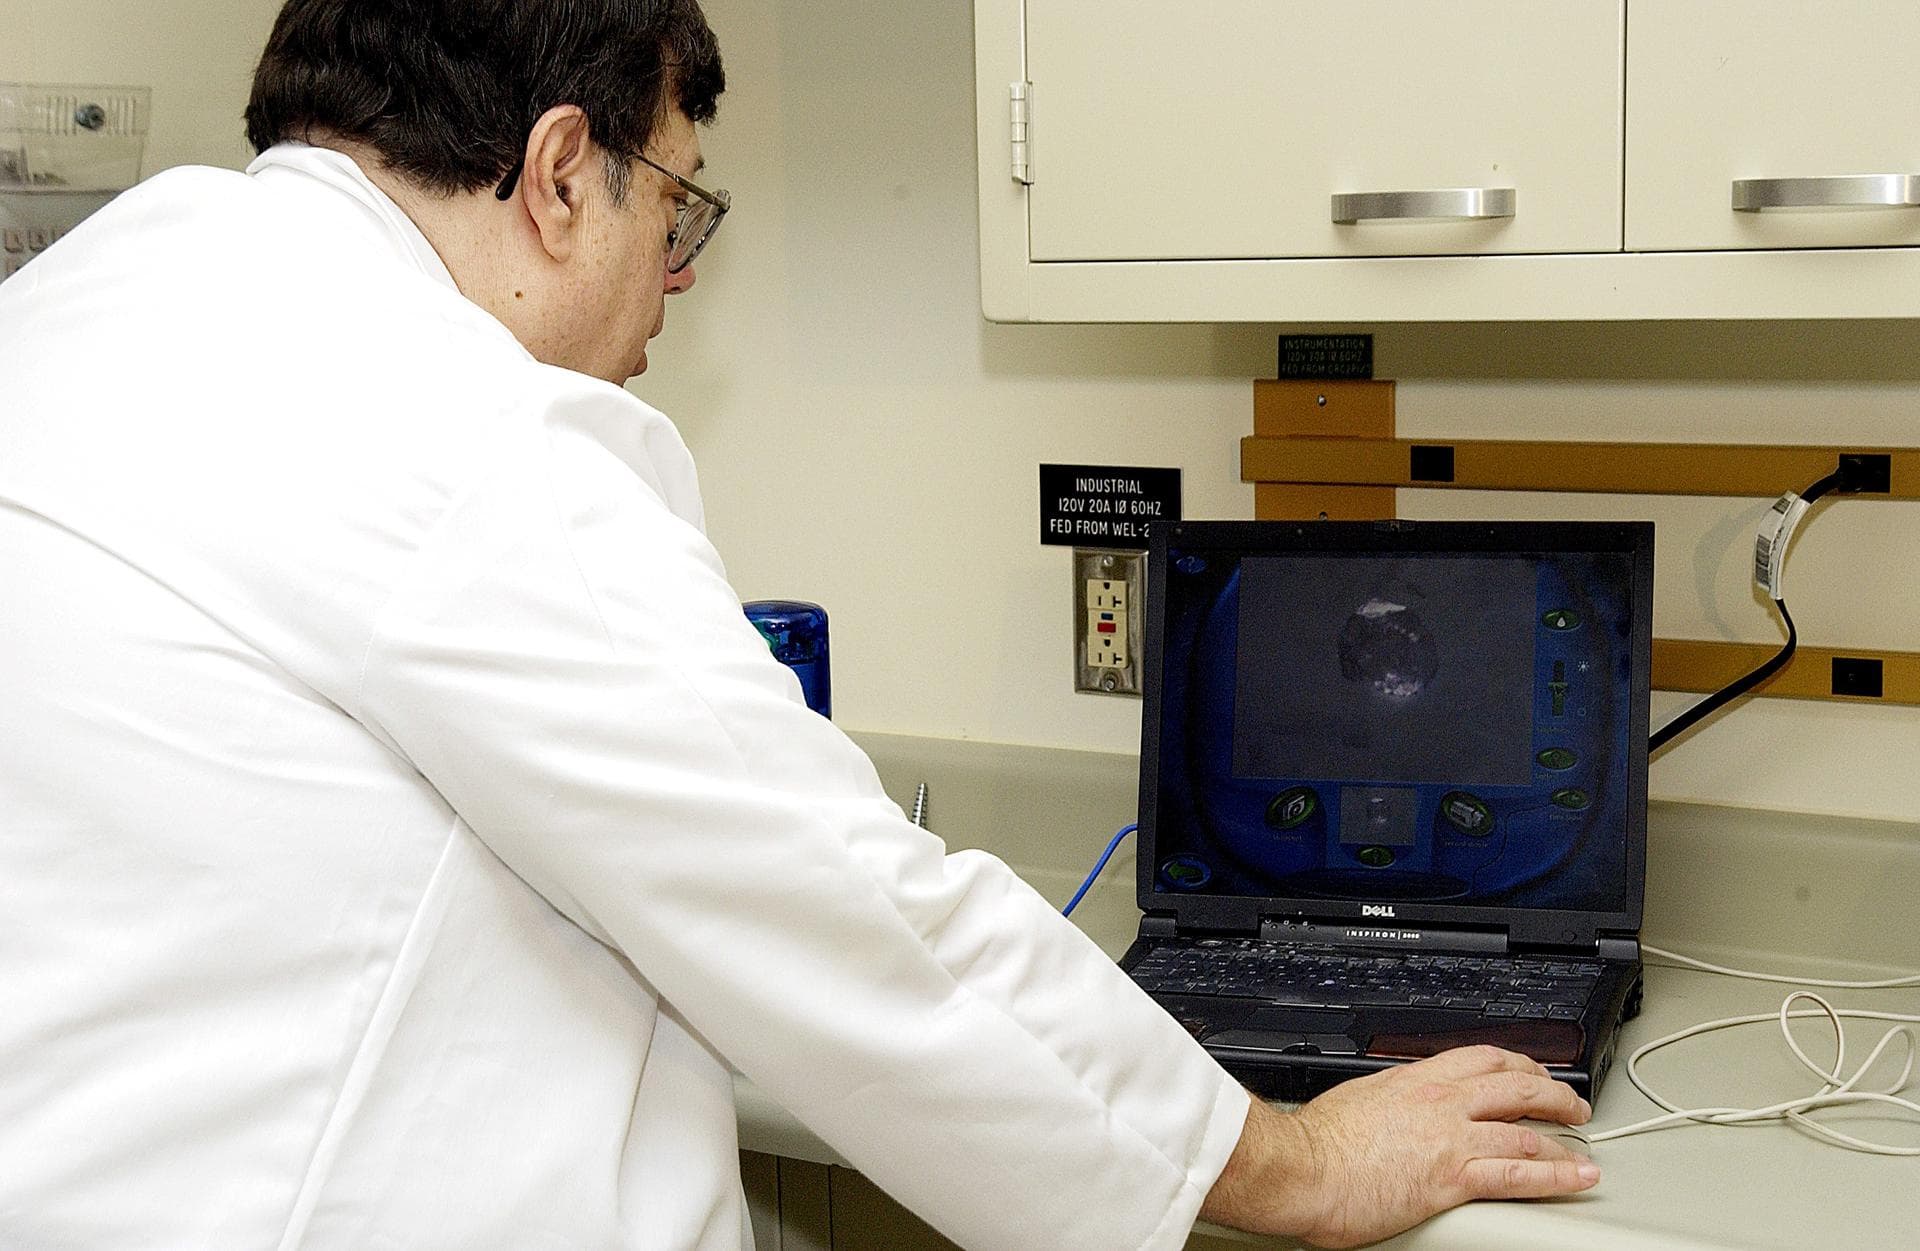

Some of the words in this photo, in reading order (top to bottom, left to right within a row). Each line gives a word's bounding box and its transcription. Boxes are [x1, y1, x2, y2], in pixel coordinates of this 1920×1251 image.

[1284, 338, 1365, 350] INSTRUMENTATION
[1301, 363, 1325, 375] FROM
[1075, 478, 1144, 494] INDUSTRIAL
[1058, 497, 1085, 512] 120V
[1088, 499, 1111, 514] 20A
[1131, 500, 1162, 516] 60HZ
[1050, 518, 1072, 533] FED
[1076, 520, 1108, 535] FROM
[1362, 904, 1395, 917] DELL
[1346, 929, 1396, 938] INSPIRON
